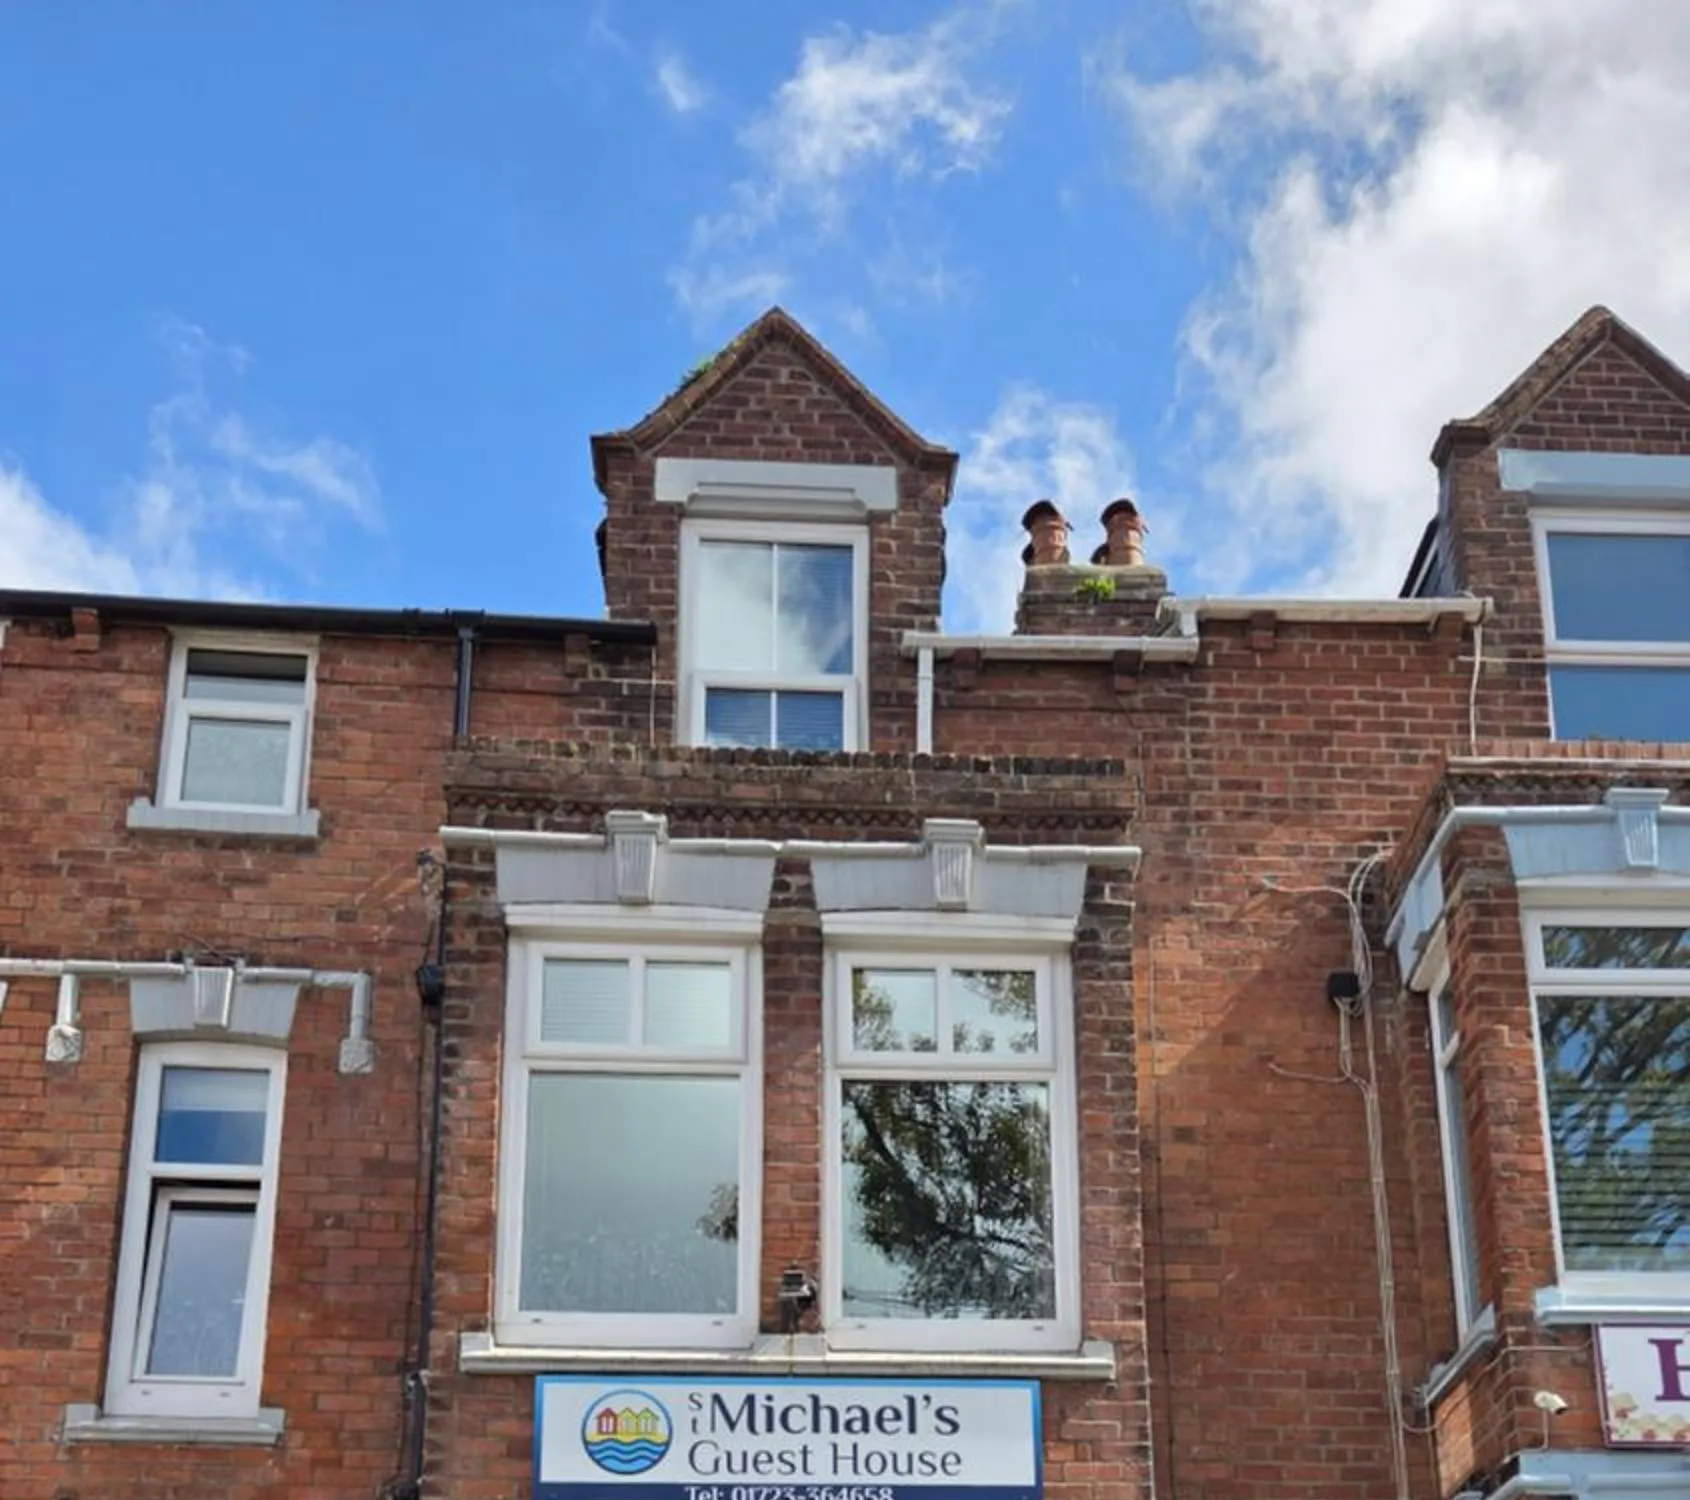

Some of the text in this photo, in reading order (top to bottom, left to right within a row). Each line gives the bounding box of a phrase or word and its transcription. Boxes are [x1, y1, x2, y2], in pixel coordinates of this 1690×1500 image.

[709, 1392, 961, 1436] Michael's
[687, 1439, 963, 1477] Guest House
